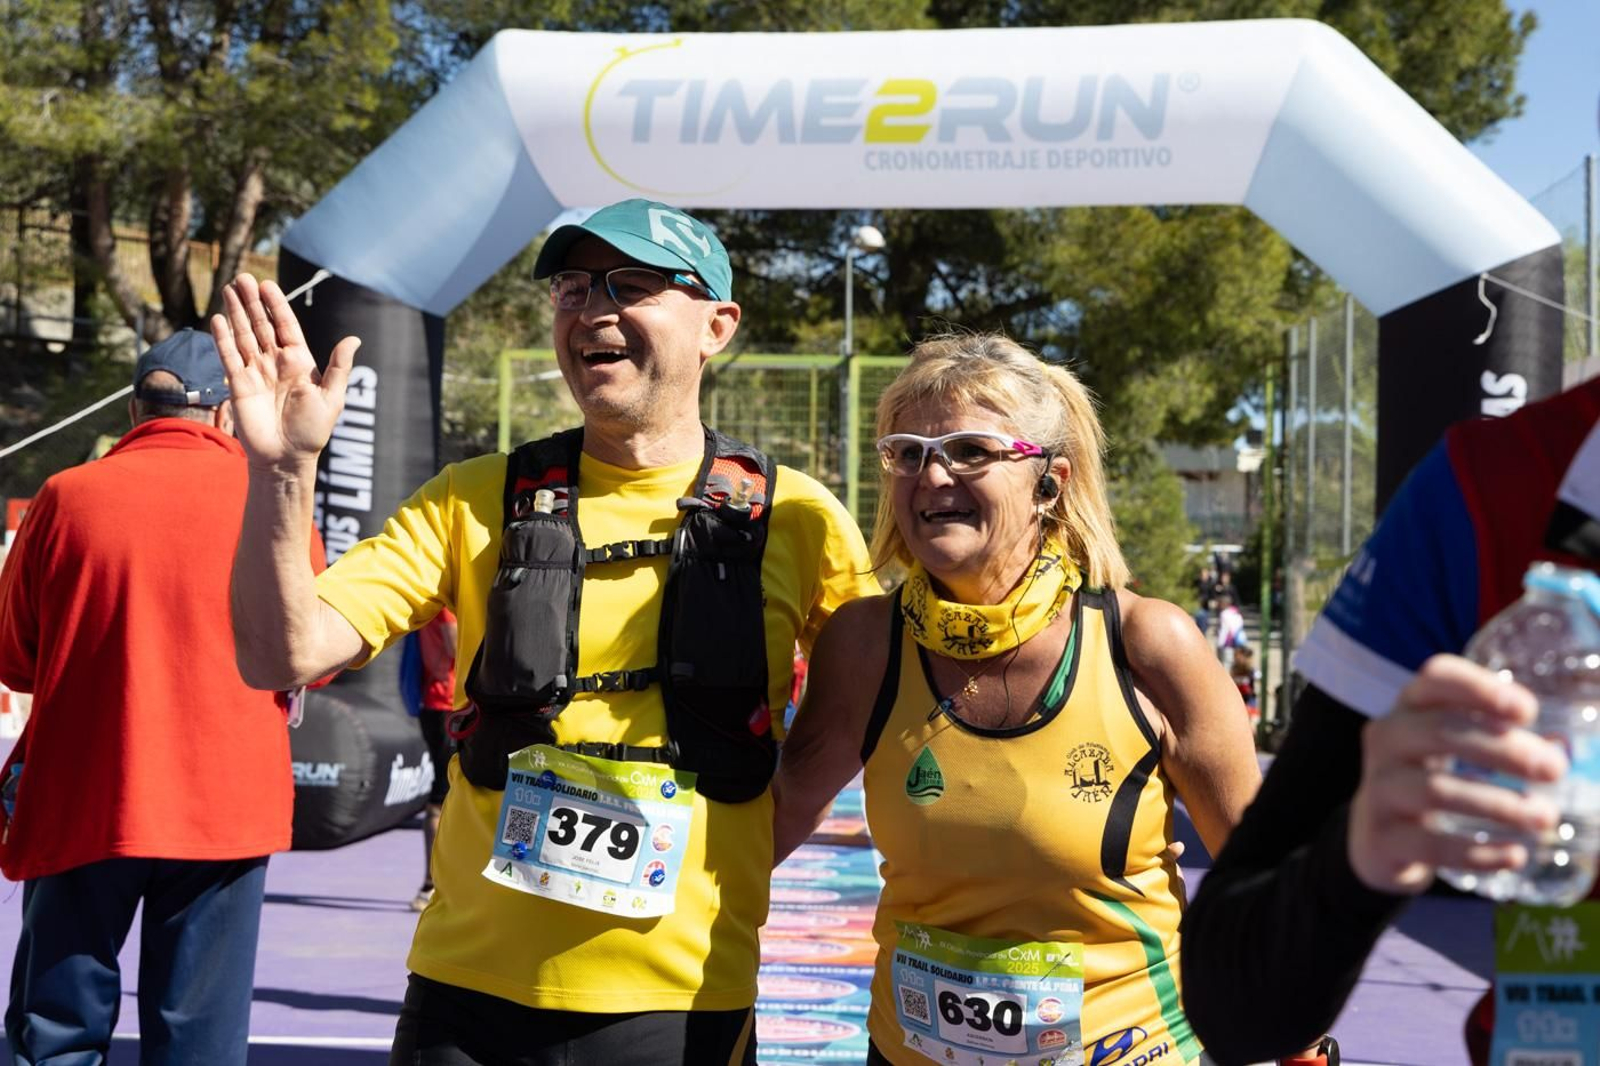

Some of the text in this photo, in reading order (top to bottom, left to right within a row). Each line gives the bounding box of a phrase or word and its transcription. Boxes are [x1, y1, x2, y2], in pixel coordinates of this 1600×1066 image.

[864, 146, 1173, 172] CRONOMETRAJE DEPORTIVO
[511, 772, 524, 785] VII
[548, 807, 641, 861] 379
[1008, 946, 1041, 962] CxM
[896, 953, 907, 965] VII
[908, 957, 929, 972] TRAIL
[930, 964, 974, 984] SOLIDARIO
[1007, 961, 1040, 974] 2025
[938, 991, 1023, 1037] 630
